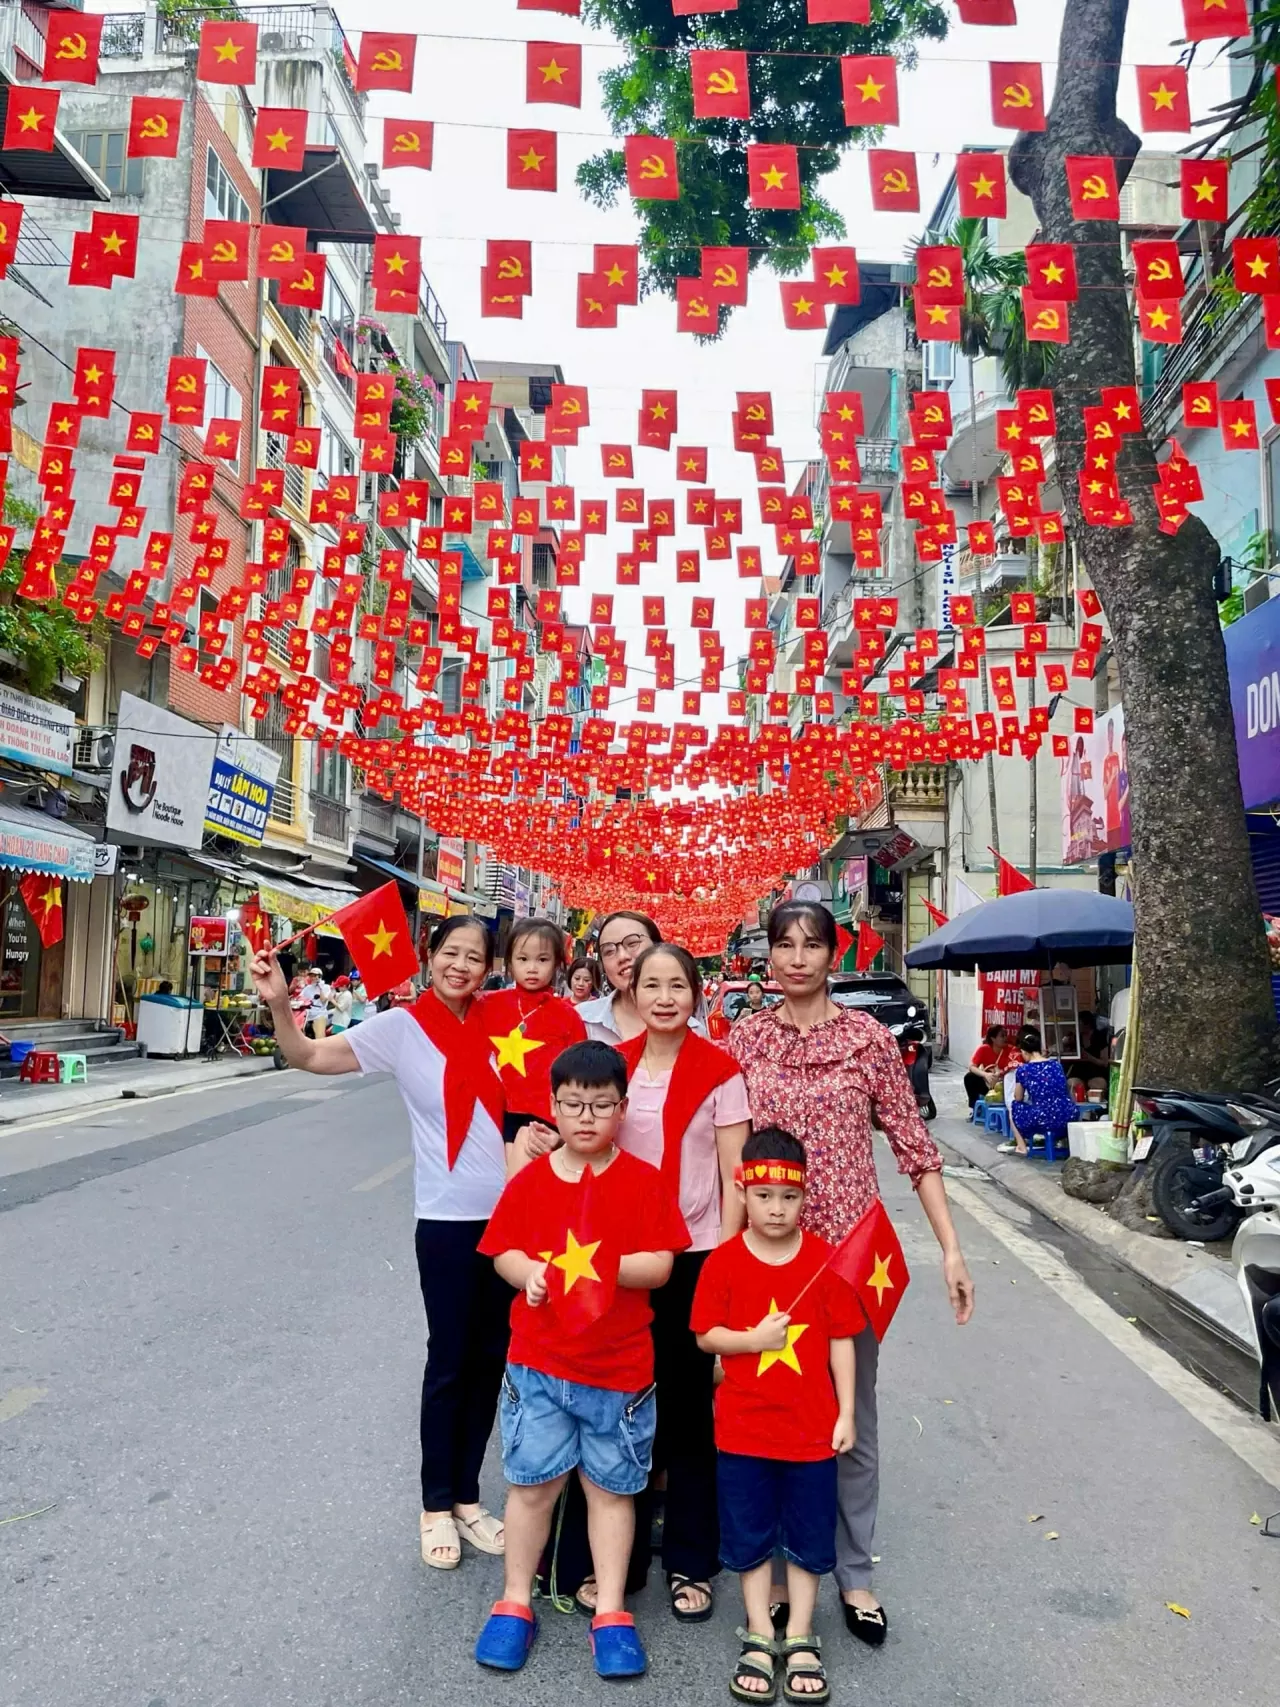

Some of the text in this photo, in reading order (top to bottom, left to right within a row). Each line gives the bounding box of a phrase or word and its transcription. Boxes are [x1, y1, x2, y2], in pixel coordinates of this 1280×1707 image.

[942, 544, 954, 584] NGLISH
[231, 773, 250, 798] LÂM
[249, 783, 268, 807] HOA
[162, 802, 181, 817] Boutique
[154, 811, 184, 826] Noodle House
[8, 918, 26, 928] When
[8, 933, 27, 944] You're
[6, 949, 29, 961] Hungry
[769, 1165, 786, 1181] VIỆT
[788, 1168, 801, 1182] NAM
